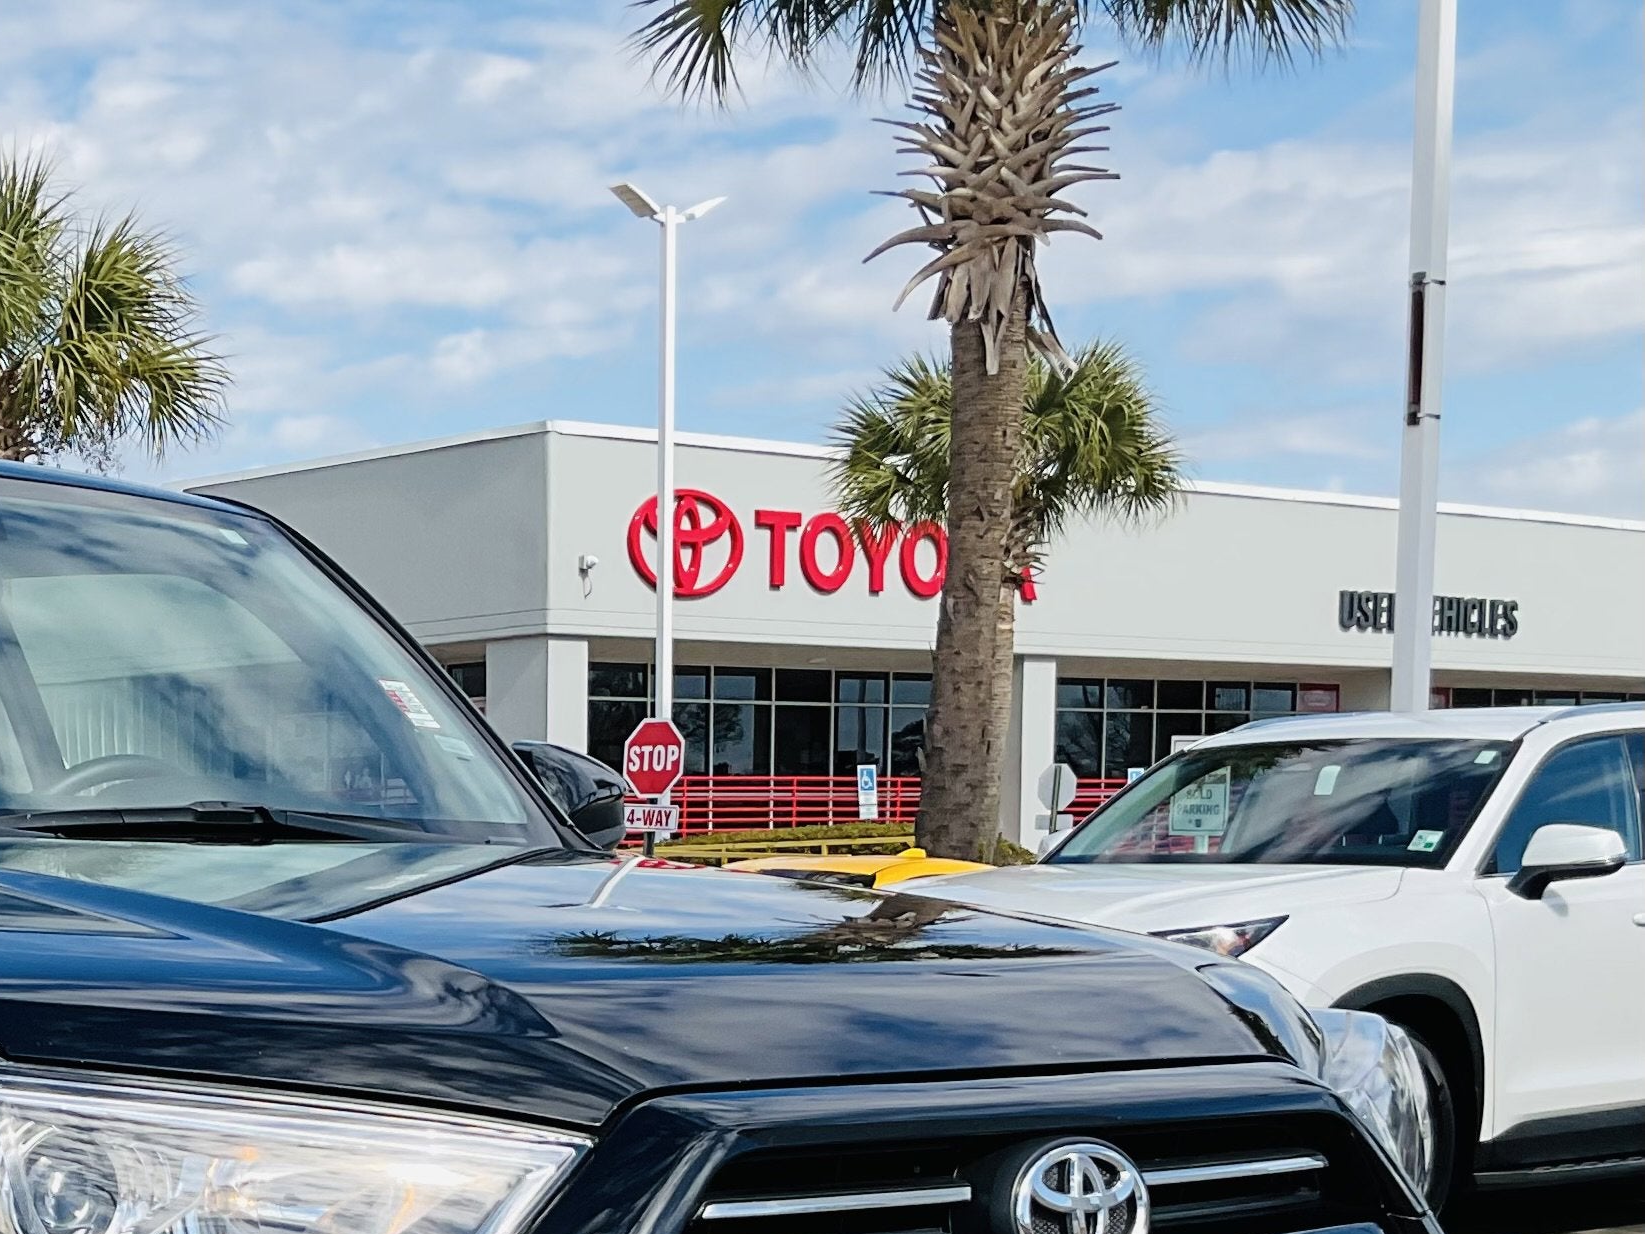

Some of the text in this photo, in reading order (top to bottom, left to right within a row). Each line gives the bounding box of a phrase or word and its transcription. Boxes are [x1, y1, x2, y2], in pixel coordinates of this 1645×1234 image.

[754, 509, 1037, 601] TOYO
[1431, 595, 1518, 639] EHICLES
[628, 744, 679, 772] STOP
[627, 809, 672, 827] 4-WAY
[1177, 803, 1220, 815] PARKING
